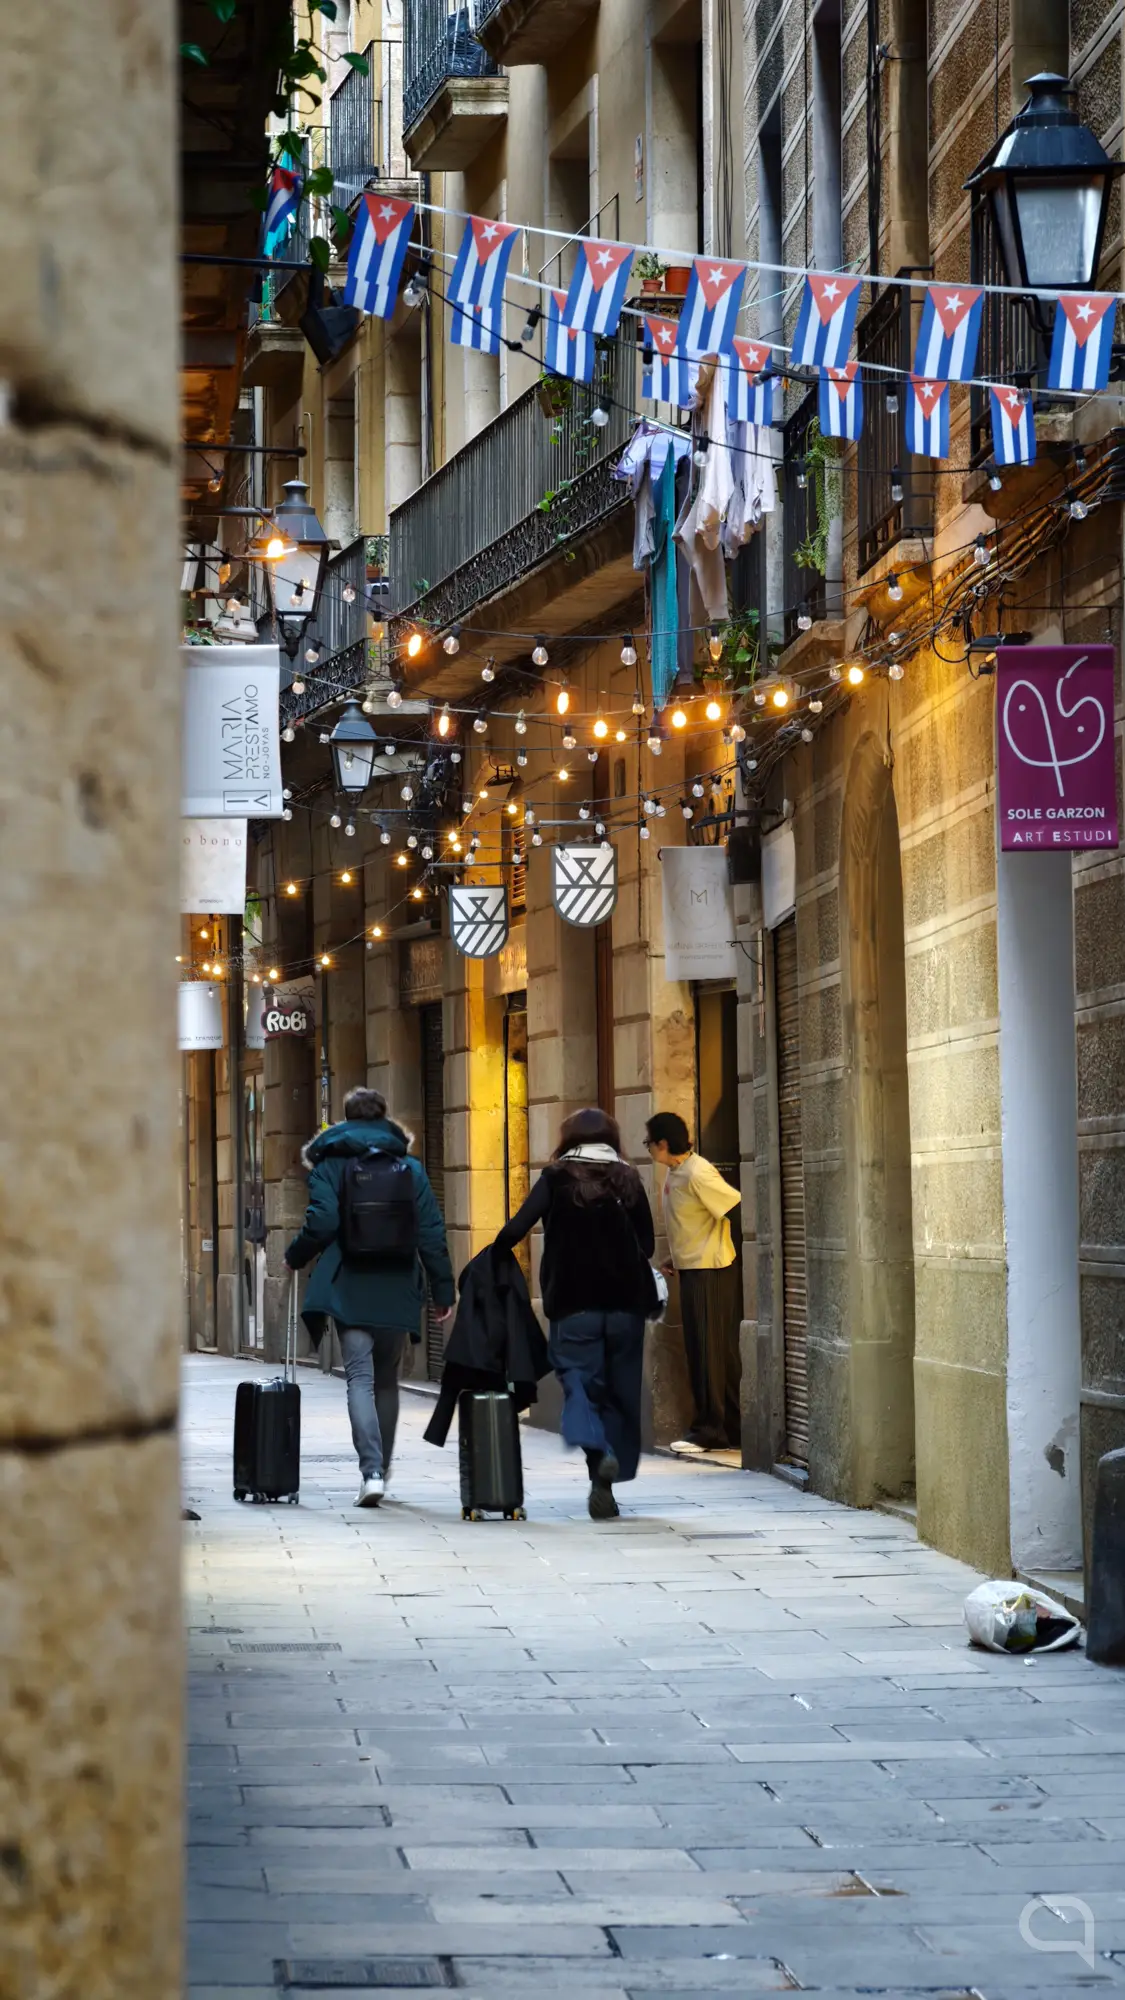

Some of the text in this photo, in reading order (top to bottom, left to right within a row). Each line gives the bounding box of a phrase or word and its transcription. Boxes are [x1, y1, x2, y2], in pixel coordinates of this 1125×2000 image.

[221, 696, 243, 780] MARIA
[244, 684, 260, 780] PRESTAMO
[261, 727, 270, 780] NO-JOYAS
[1007, 807, 1105, 820] SOLE GARZON
[200, 834, 242, 846] bono
[1013, 830, 1112, 843] ART ESTUDI
